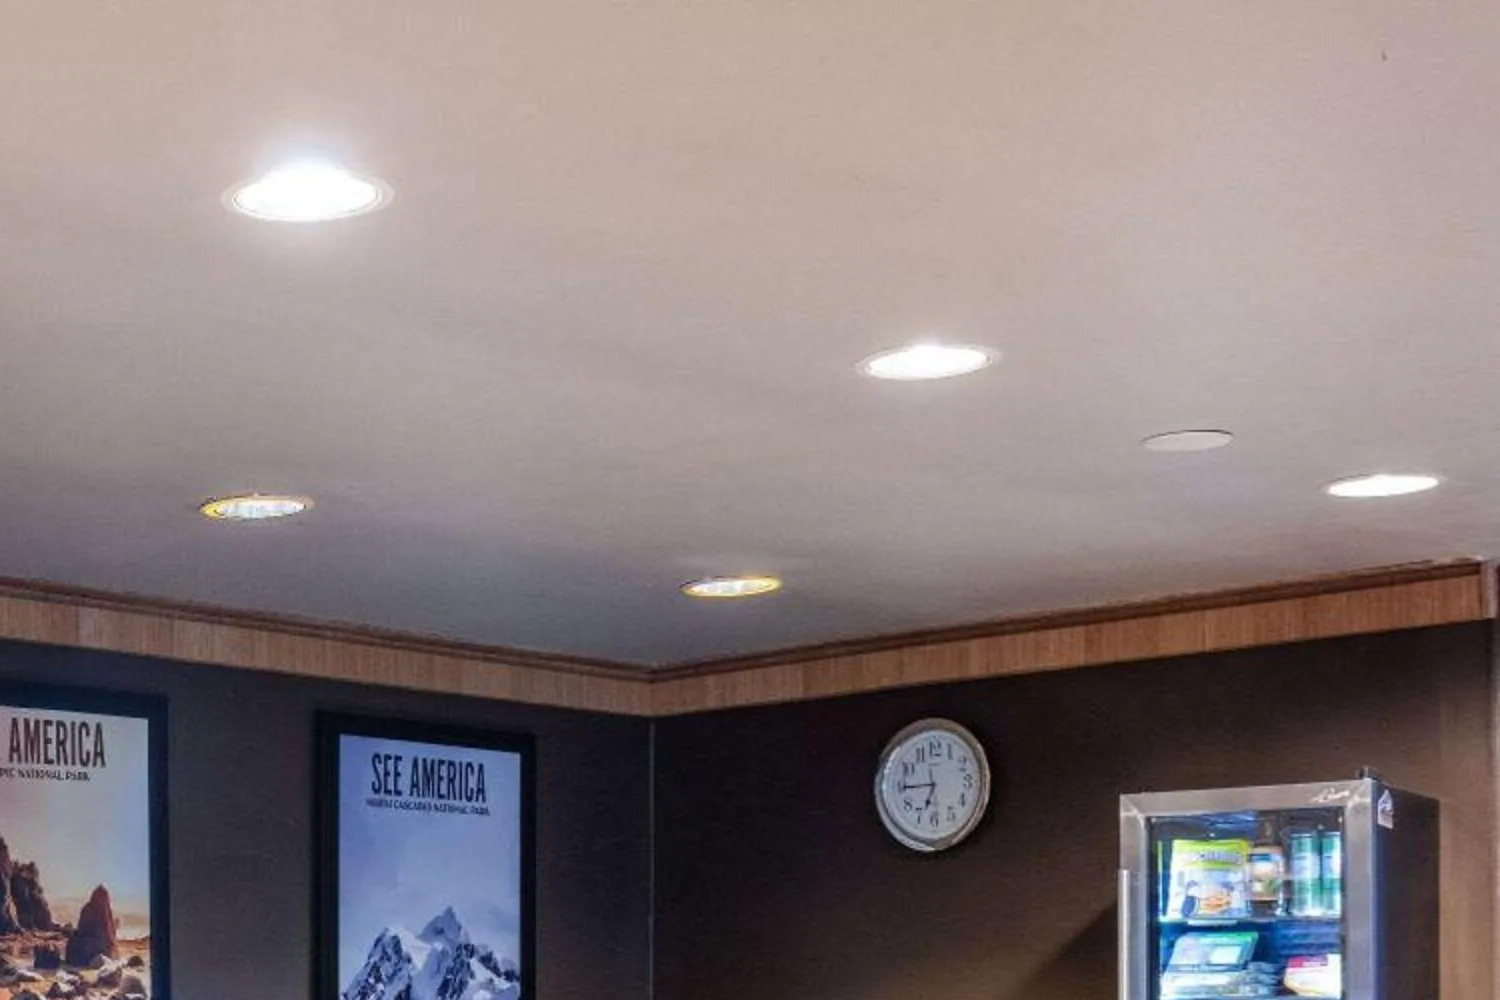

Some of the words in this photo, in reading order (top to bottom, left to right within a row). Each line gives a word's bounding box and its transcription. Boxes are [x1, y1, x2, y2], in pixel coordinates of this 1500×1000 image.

[9, 718, 107, 768] AMERICA
[372, 753, 403, 796] SEE
[409, 756, 486, 803] AMERICA
